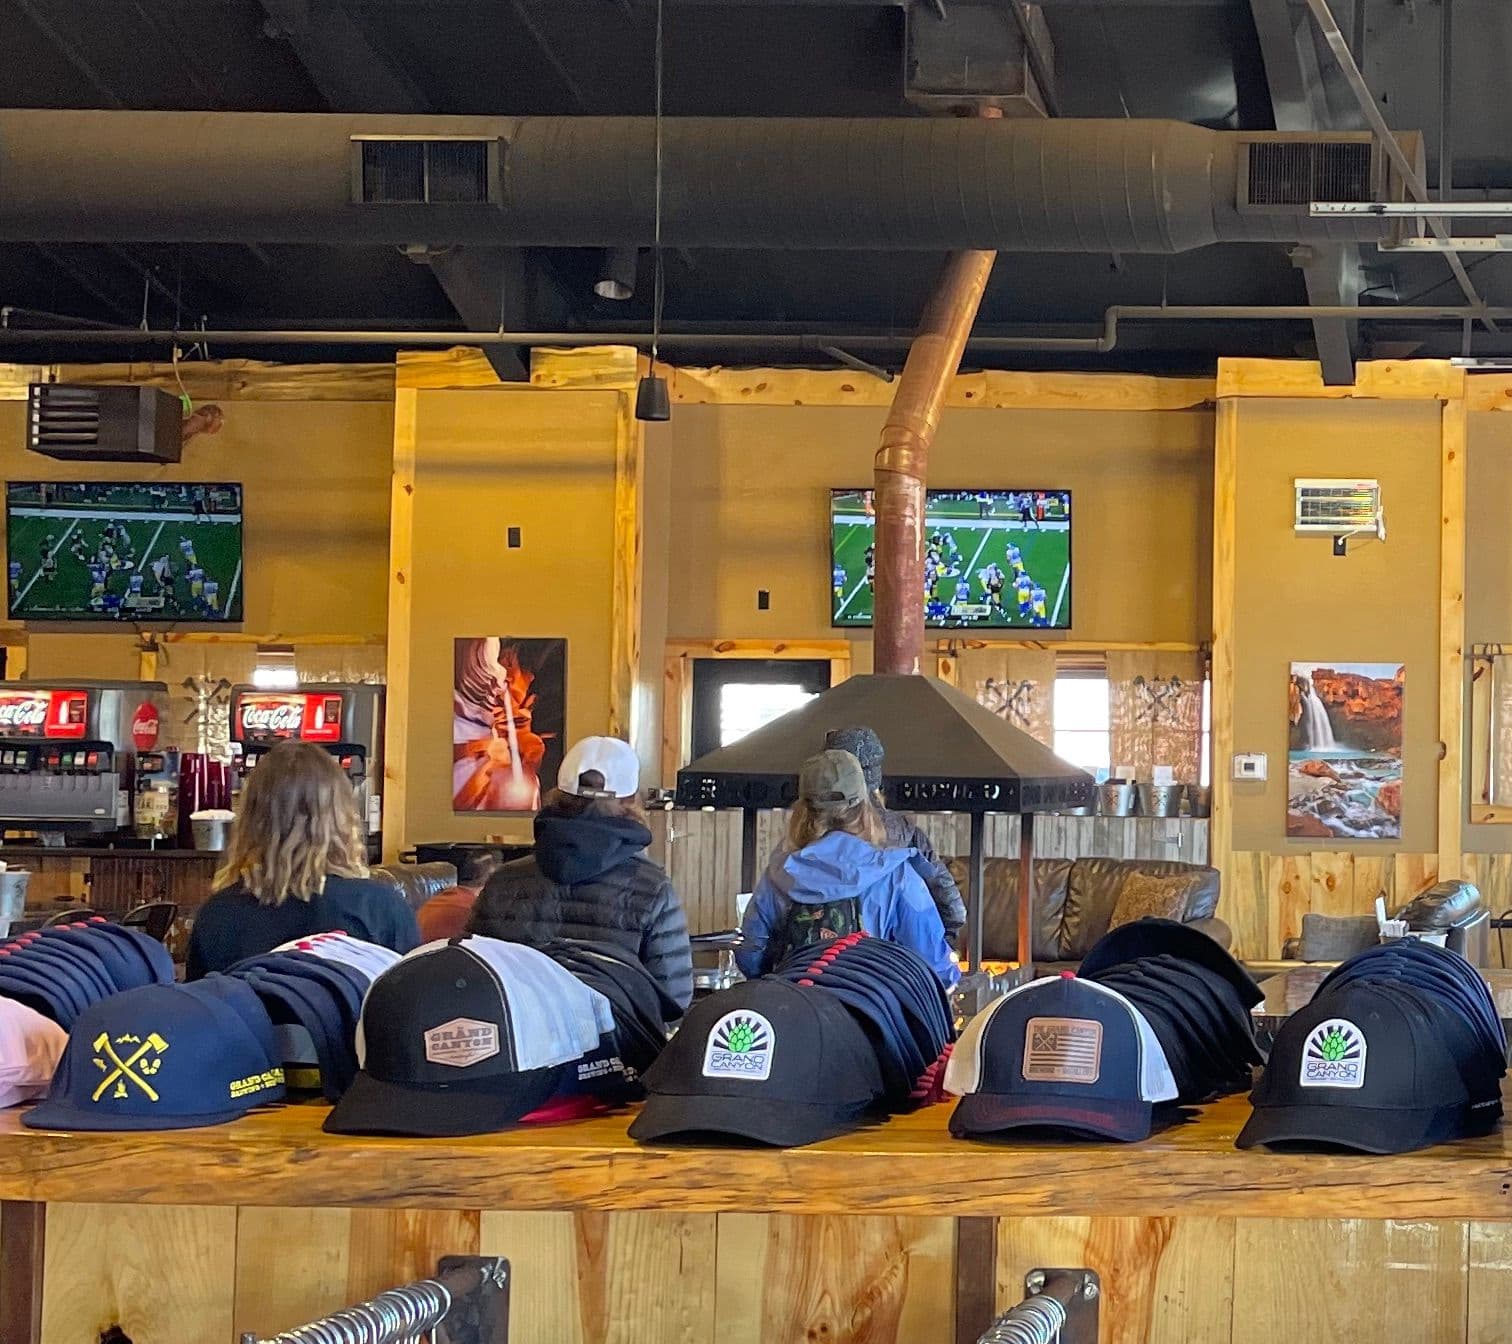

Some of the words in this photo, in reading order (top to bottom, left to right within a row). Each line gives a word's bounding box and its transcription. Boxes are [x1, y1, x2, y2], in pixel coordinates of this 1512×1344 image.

[430, 1027, 494, 1042] GRAND
[431, 1037, 494, 1051] CANYON
[711, 1052, 765, 1064] GRAND
[710, 1060, 764, 1071] CANYON
[1307, 1062, 1359, 1072] GRAND
[1306, 1070, 1357, 1079] CANYON
